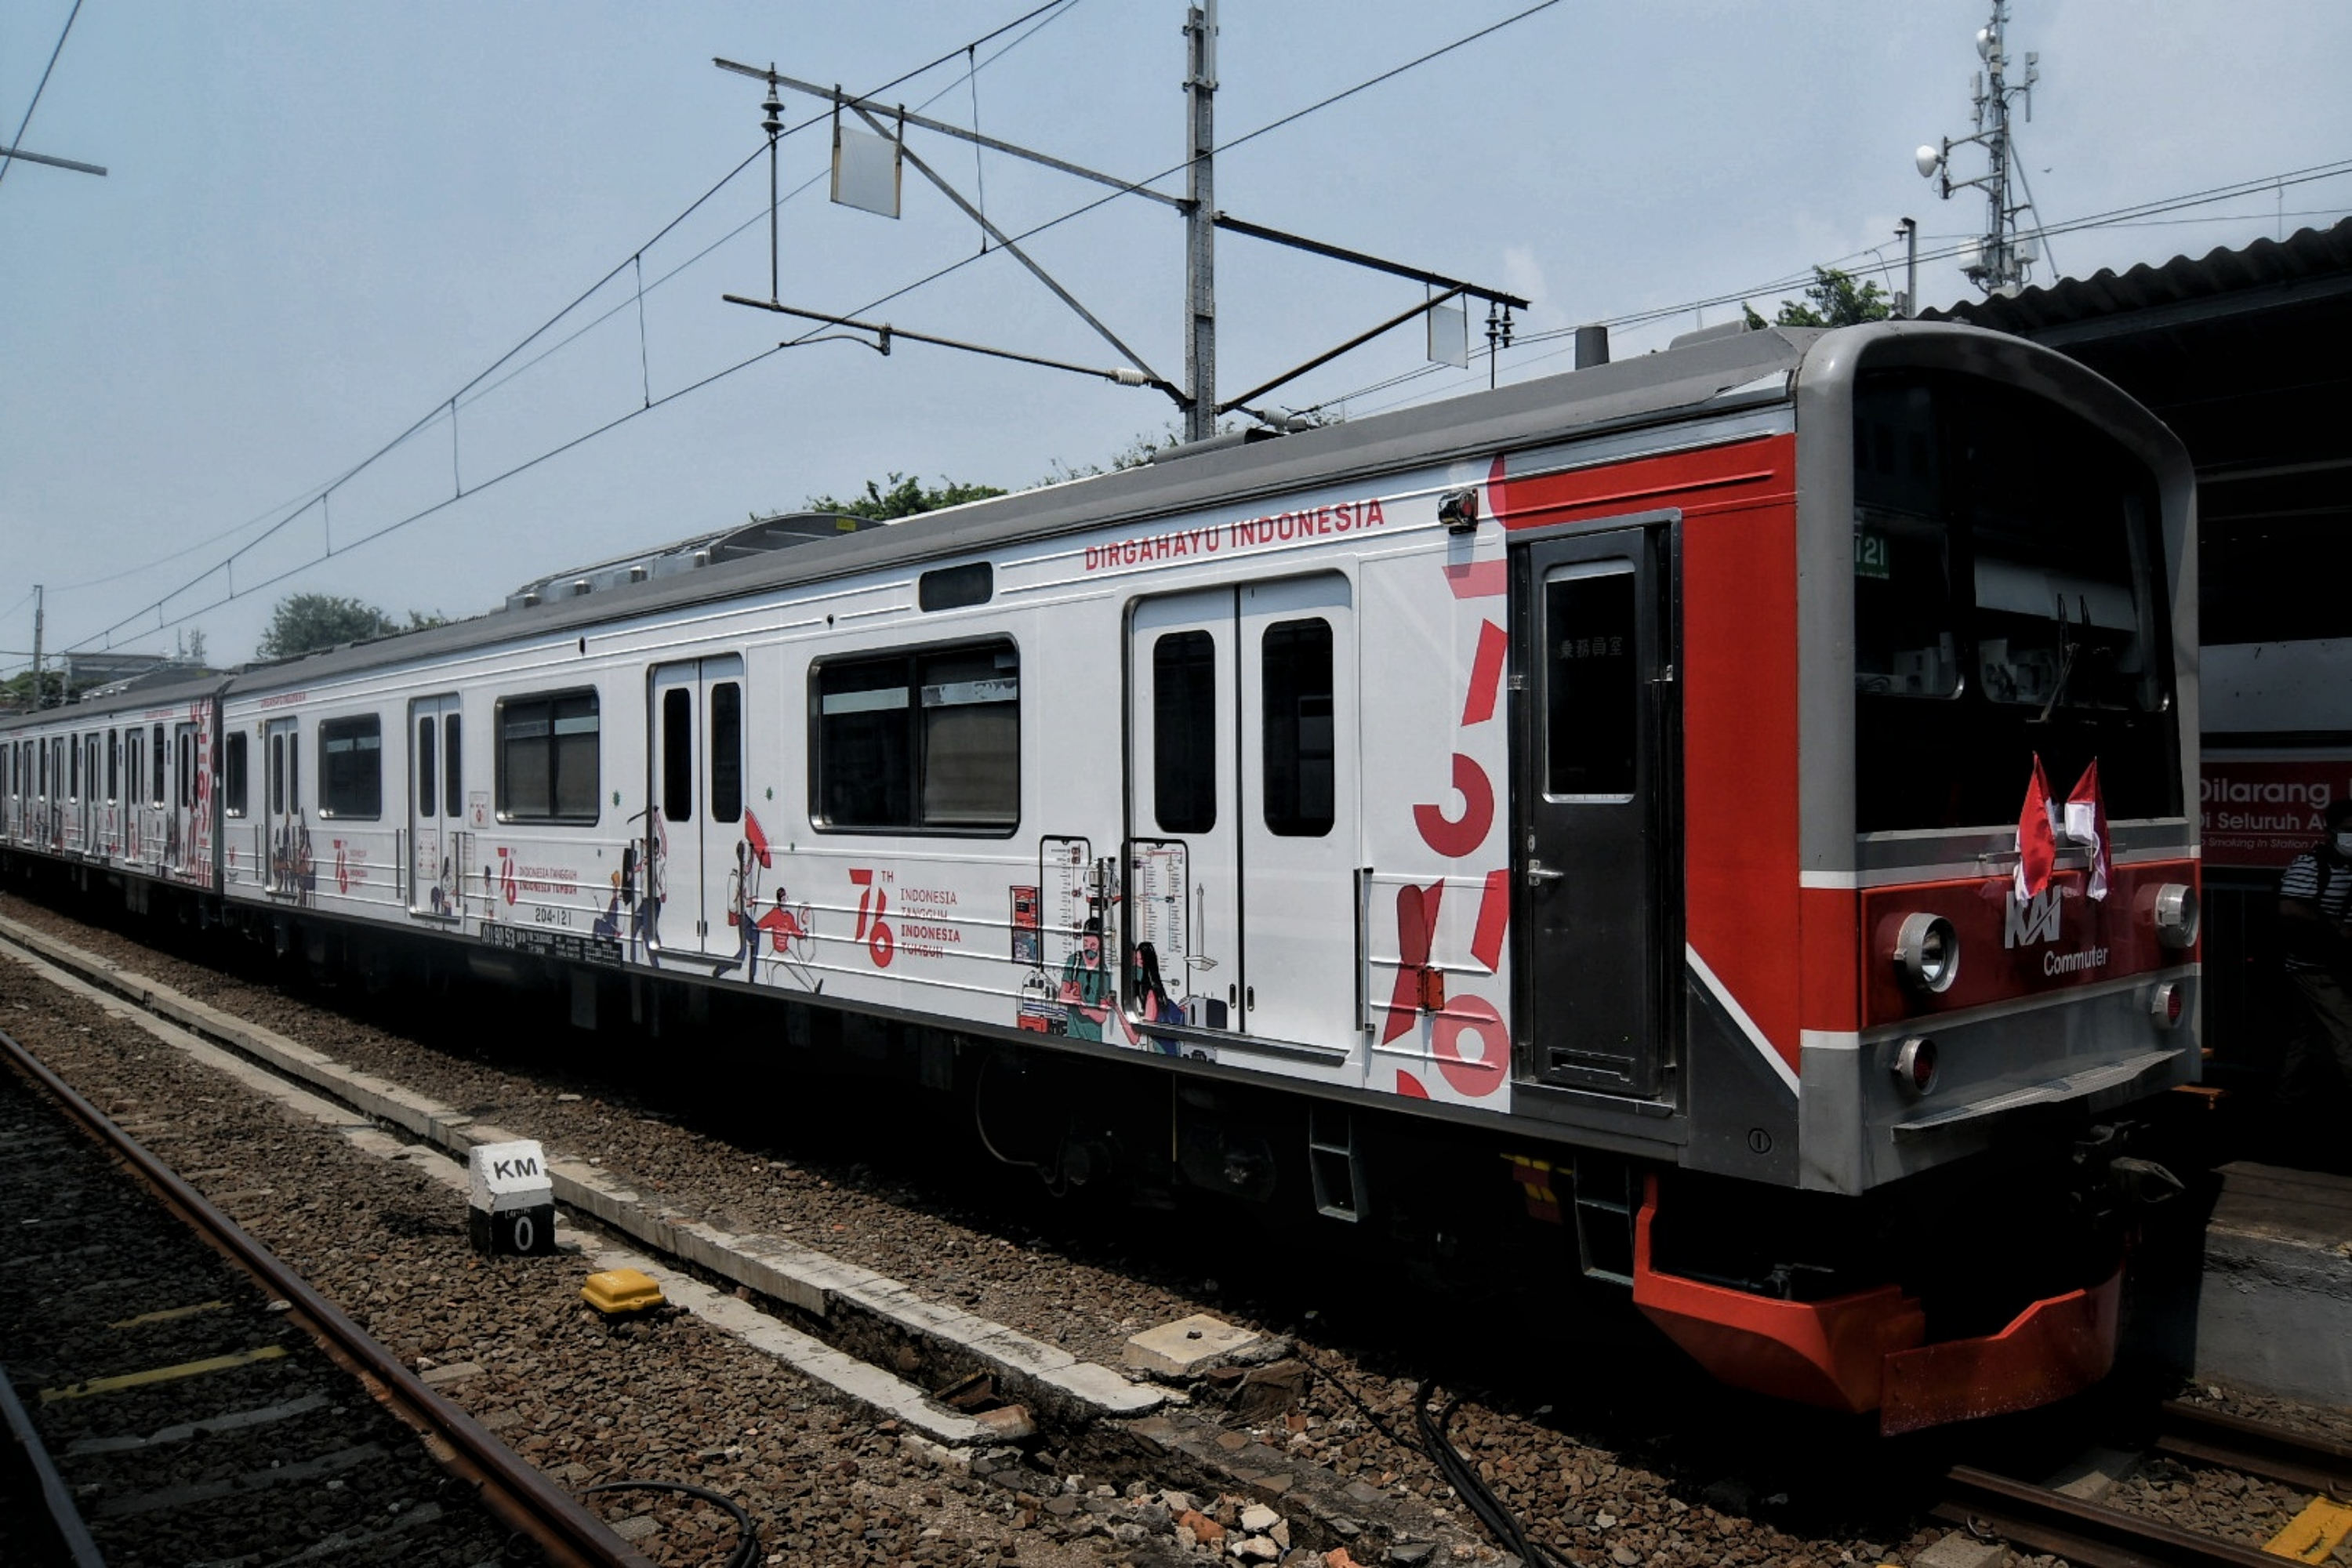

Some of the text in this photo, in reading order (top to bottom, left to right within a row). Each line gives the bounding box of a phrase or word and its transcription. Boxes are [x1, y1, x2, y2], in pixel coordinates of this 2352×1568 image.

[1085, 499, 1385, 571] DIRGAHAYU INDONESIA
[2217, 811, 2301, 830] Seluruh
[2208, 837, 2255, 851] Smoking
[2270, 838, 2309, 849] Station
[900, 887, 958, 905] INDONESIA
[535, 907, 572, 926] 204-121
[848, 867, 894, 968] 76 TH
[2005, 884, 2062, 950] KAI
[901, 924, 961, 943] INDONESIA
[2043, 945, 2108, 977] Commuter
[493, 1156, 538, 1180] KM
[514, 1216, 534, 1251] 0
